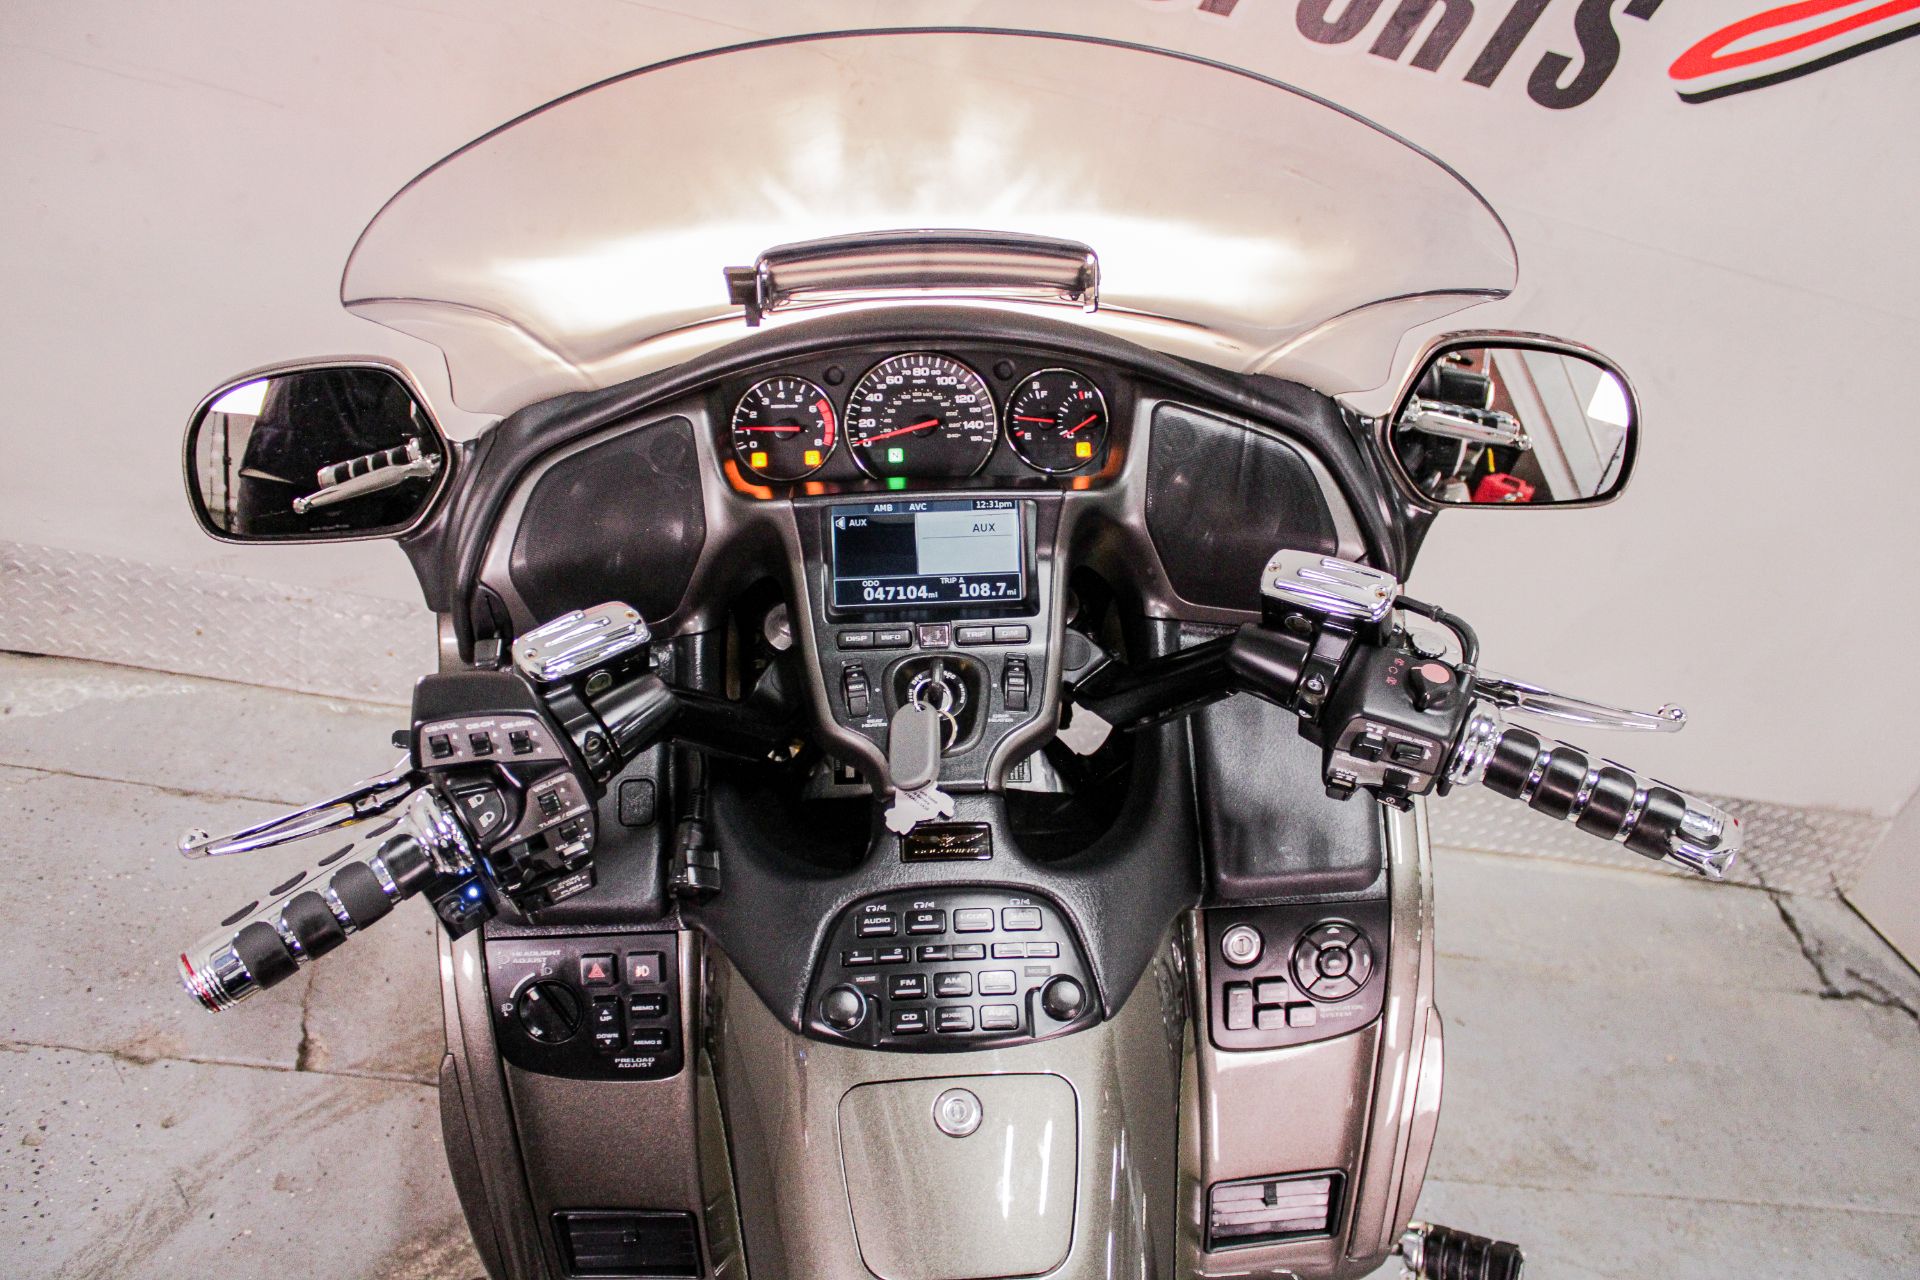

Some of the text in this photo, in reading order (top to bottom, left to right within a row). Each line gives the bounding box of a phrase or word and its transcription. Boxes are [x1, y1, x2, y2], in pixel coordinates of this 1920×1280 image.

[912, 368, 930, 376] 80
[886, 376, 903, 384] 60
[936, 376, 958, 385] 100
[865, 393, 883, 402] 40
[954, 394, 976, 403] 120
[858, 419, 876, 428] 20
[962, 420, 984, 430] 140
[750, 440, 758, 448] 0
[814, 438, 822, 446] 8
[874, 500, 1012, 512] AMB AVC 12:31pm
[849, 518, 867, 526] AUX
[972, 523, 996, 532] AUX
